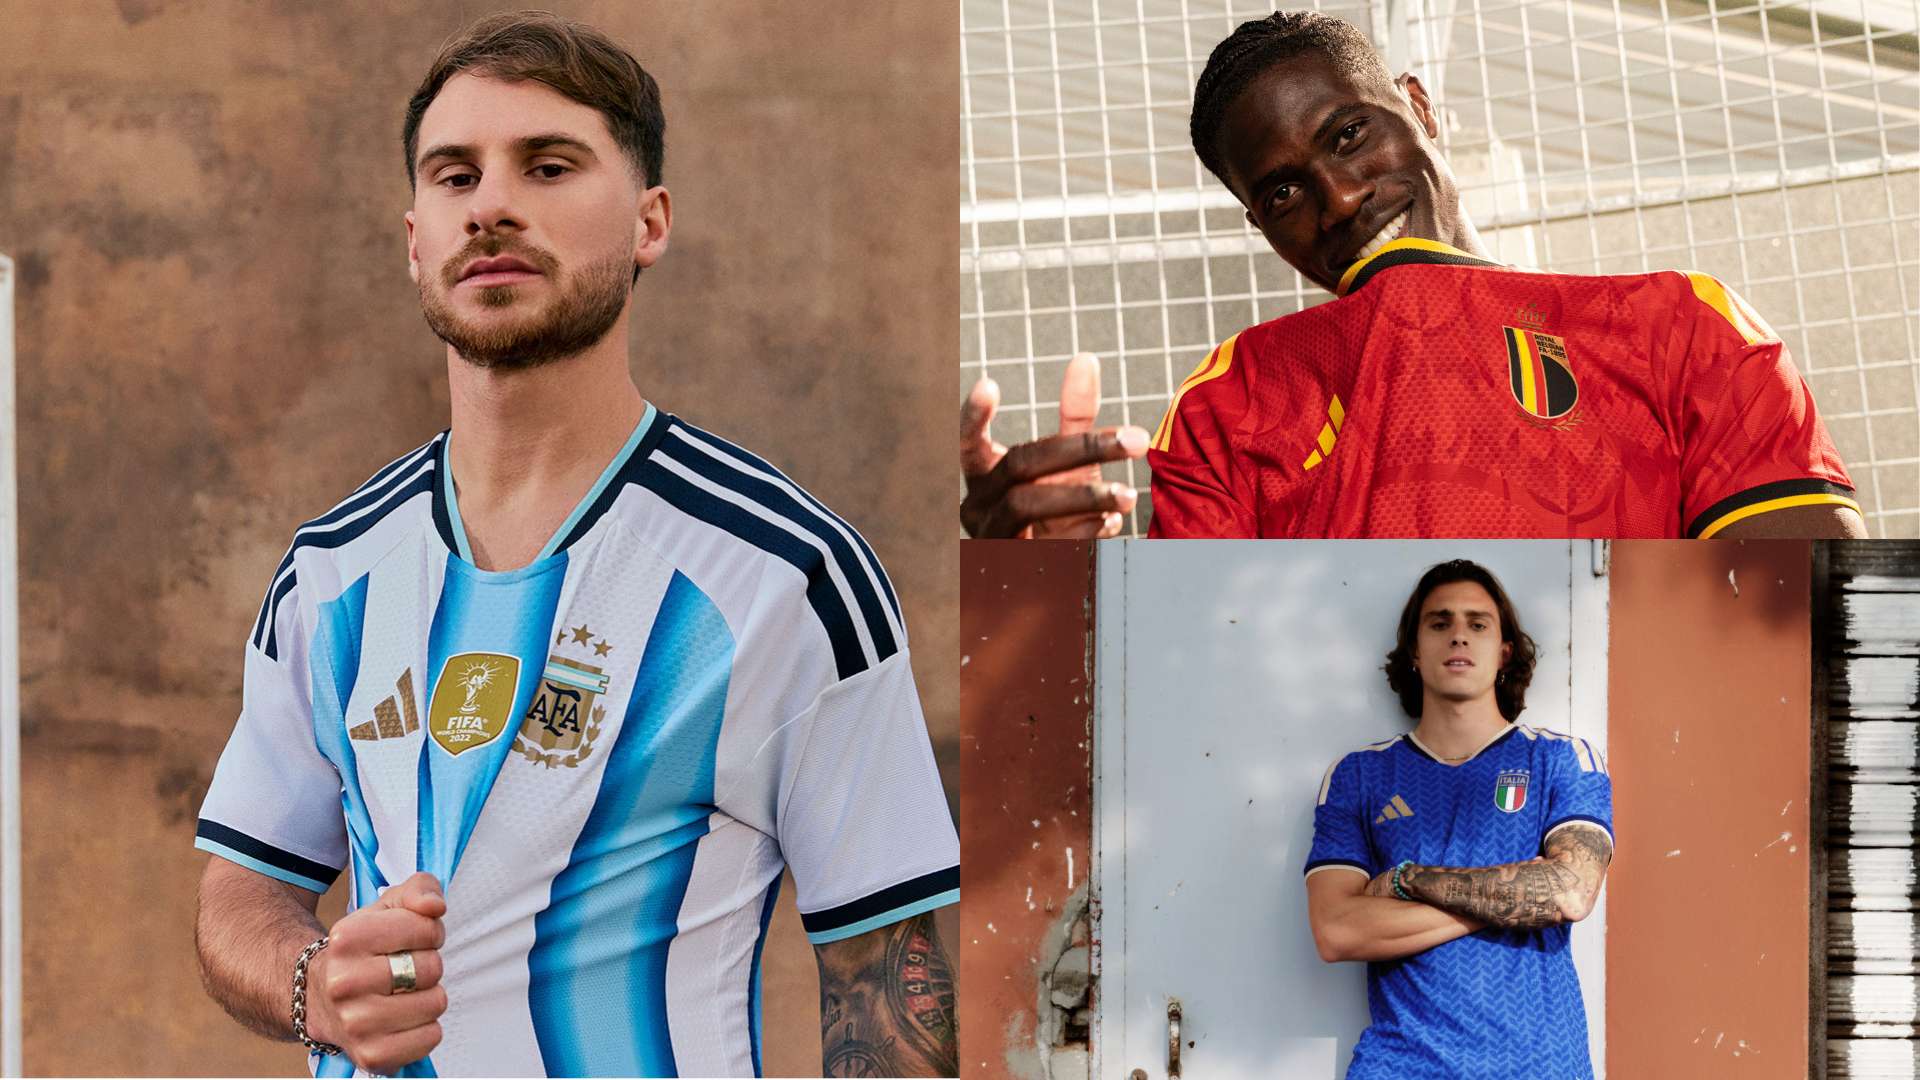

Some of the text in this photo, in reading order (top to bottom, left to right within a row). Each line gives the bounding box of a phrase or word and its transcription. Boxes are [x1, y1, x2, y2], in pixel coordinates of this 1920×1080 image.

[526, 682, 581, 737] AFA
[447, 716, 483, 730] FIFA
[449, 734, 471, 742] 2022
[1500, 776, 1526, 785] ITALIA
[909, 953, 925, 964] 9
